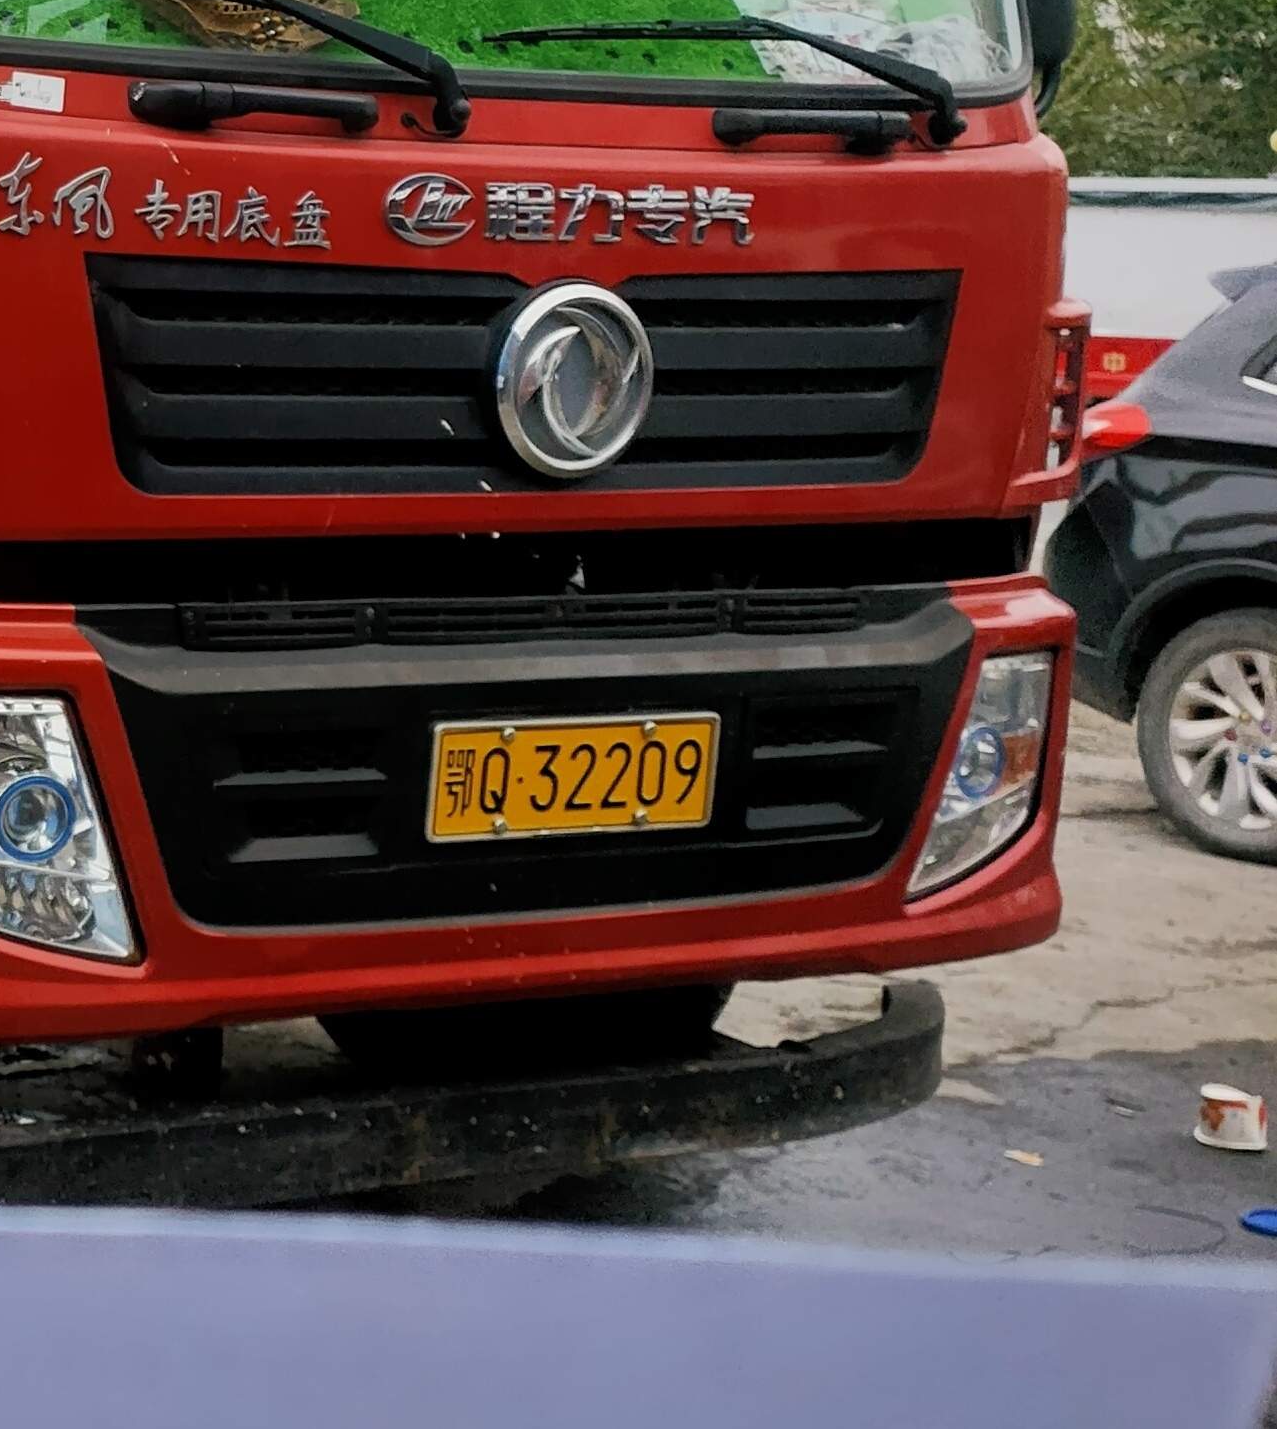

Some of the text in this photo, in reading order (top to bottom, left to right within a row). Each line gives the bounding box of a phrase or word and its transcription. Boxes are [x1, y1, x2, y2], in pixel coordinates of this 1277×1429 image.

[134, 179, 332, 250] 专用底盘
[484, 182, 755, 246] 程力专汽
